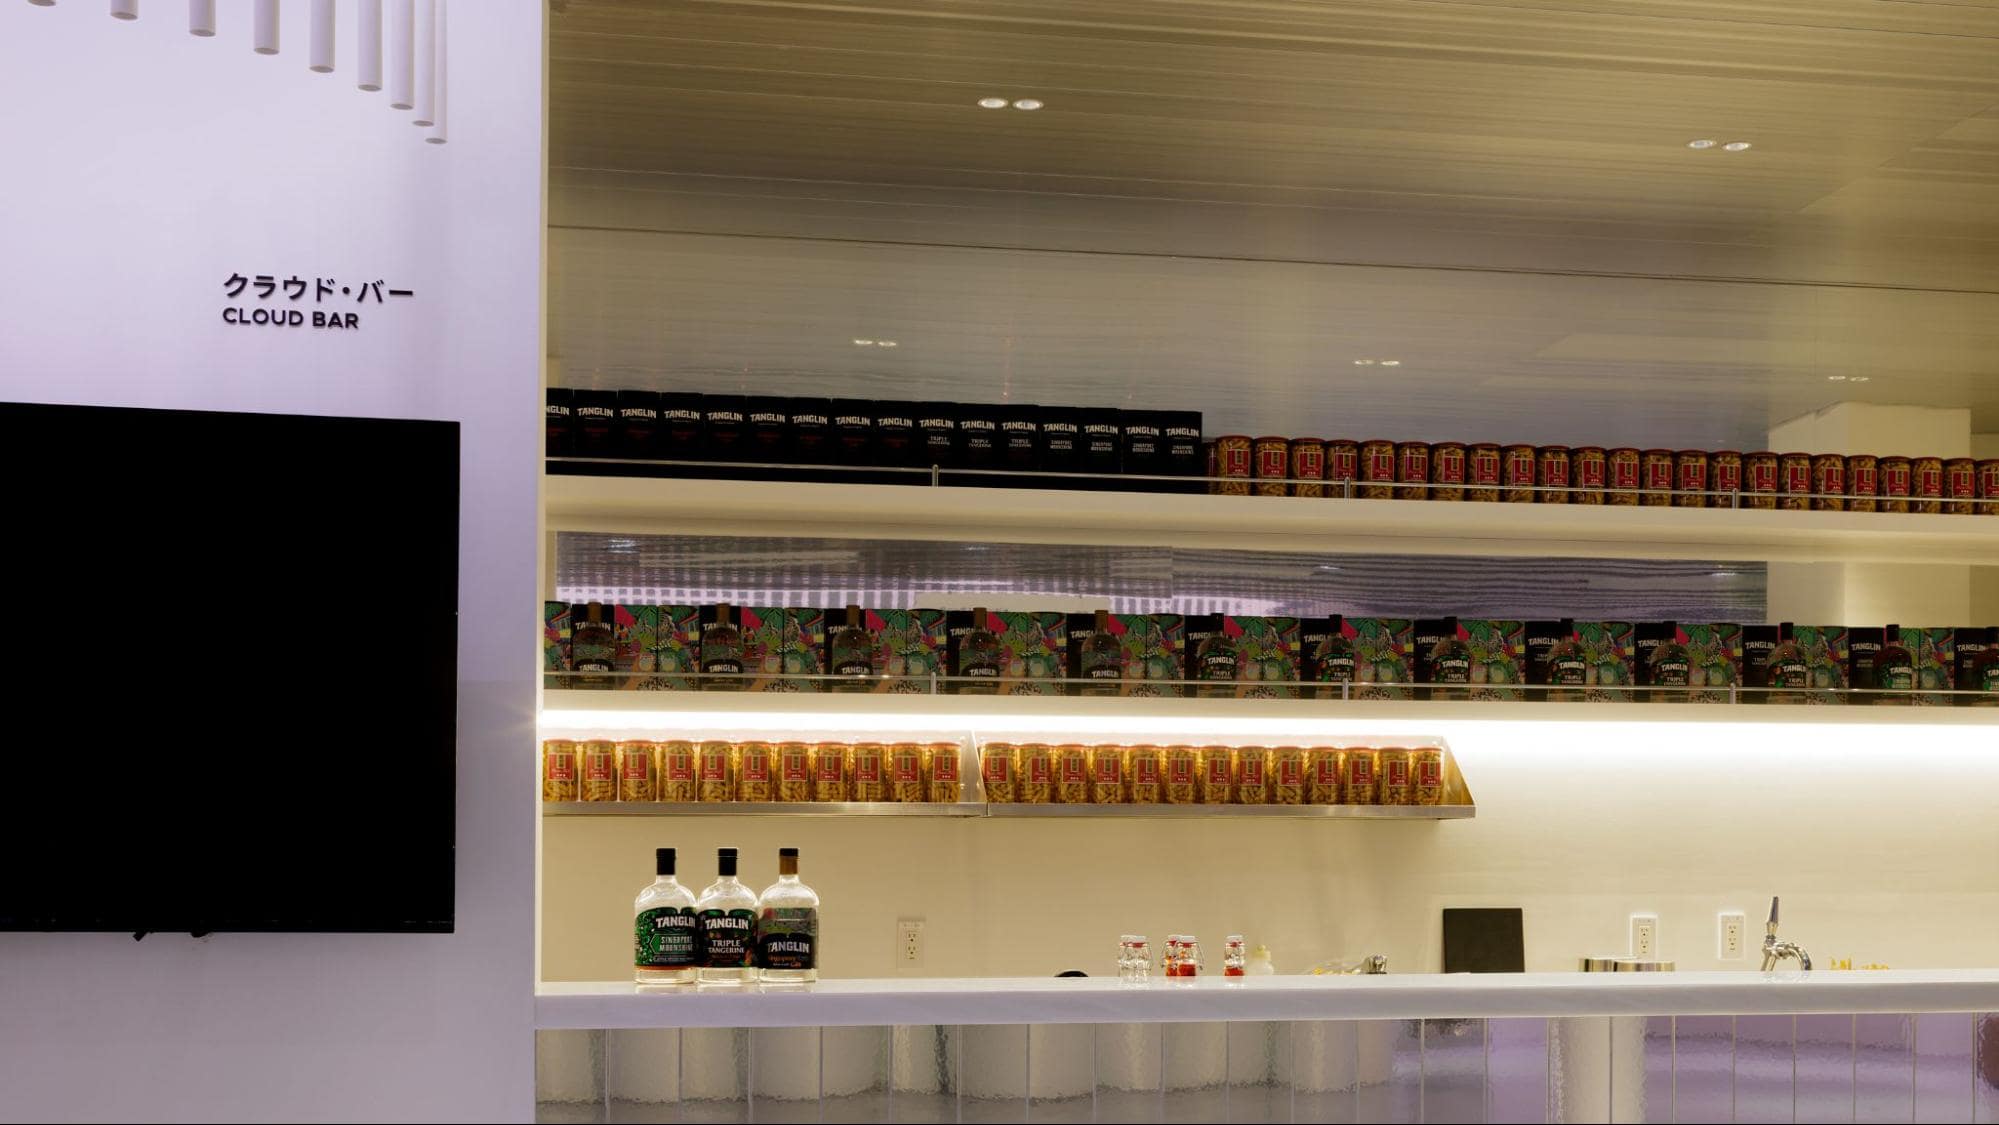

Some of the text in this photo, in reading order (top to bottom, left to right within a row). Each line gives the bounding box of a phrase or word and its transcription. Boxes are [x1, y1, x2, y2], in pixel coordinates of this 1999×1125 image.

[223, 272, 414, 303] クラウド・バー
[222, 307, 359, 329] CLOUD BAR
[577, 407, 614, 418] TANGLIN
[620, 408, 657, 419] TANGLIN
[664, 409, 701, 421] TANGLIN
[707, 411, 743, 422] TANGLIN
[749, 412, 786, 424] TANGLIN
[791, 414, 828, 425] TANGLIN
[834, 415, 871, 427] TANGLIN
[877, 417, 913, 428] TANGLIN
[918, 418, 954, 430] TANGLIN
[960, 420, 996, 431] TANGLIN
[1001, 421, 1037, 433] TANGLIN
[1042, 422, 1078, 434] TANGLIN
[1083, 424, 1119, 435] TANGLIN
[1125, 426, 1160, 437] TANGLIN
[1164, 427, 1200, 439] TANGLIN
[1850, 643, 1882, 651] TANGLIN
[709, 665, 739, 674] TANGLIN
[705, 917, 749, 930] TANGLIN
[767, 941, 810, 953] TANGLIN
